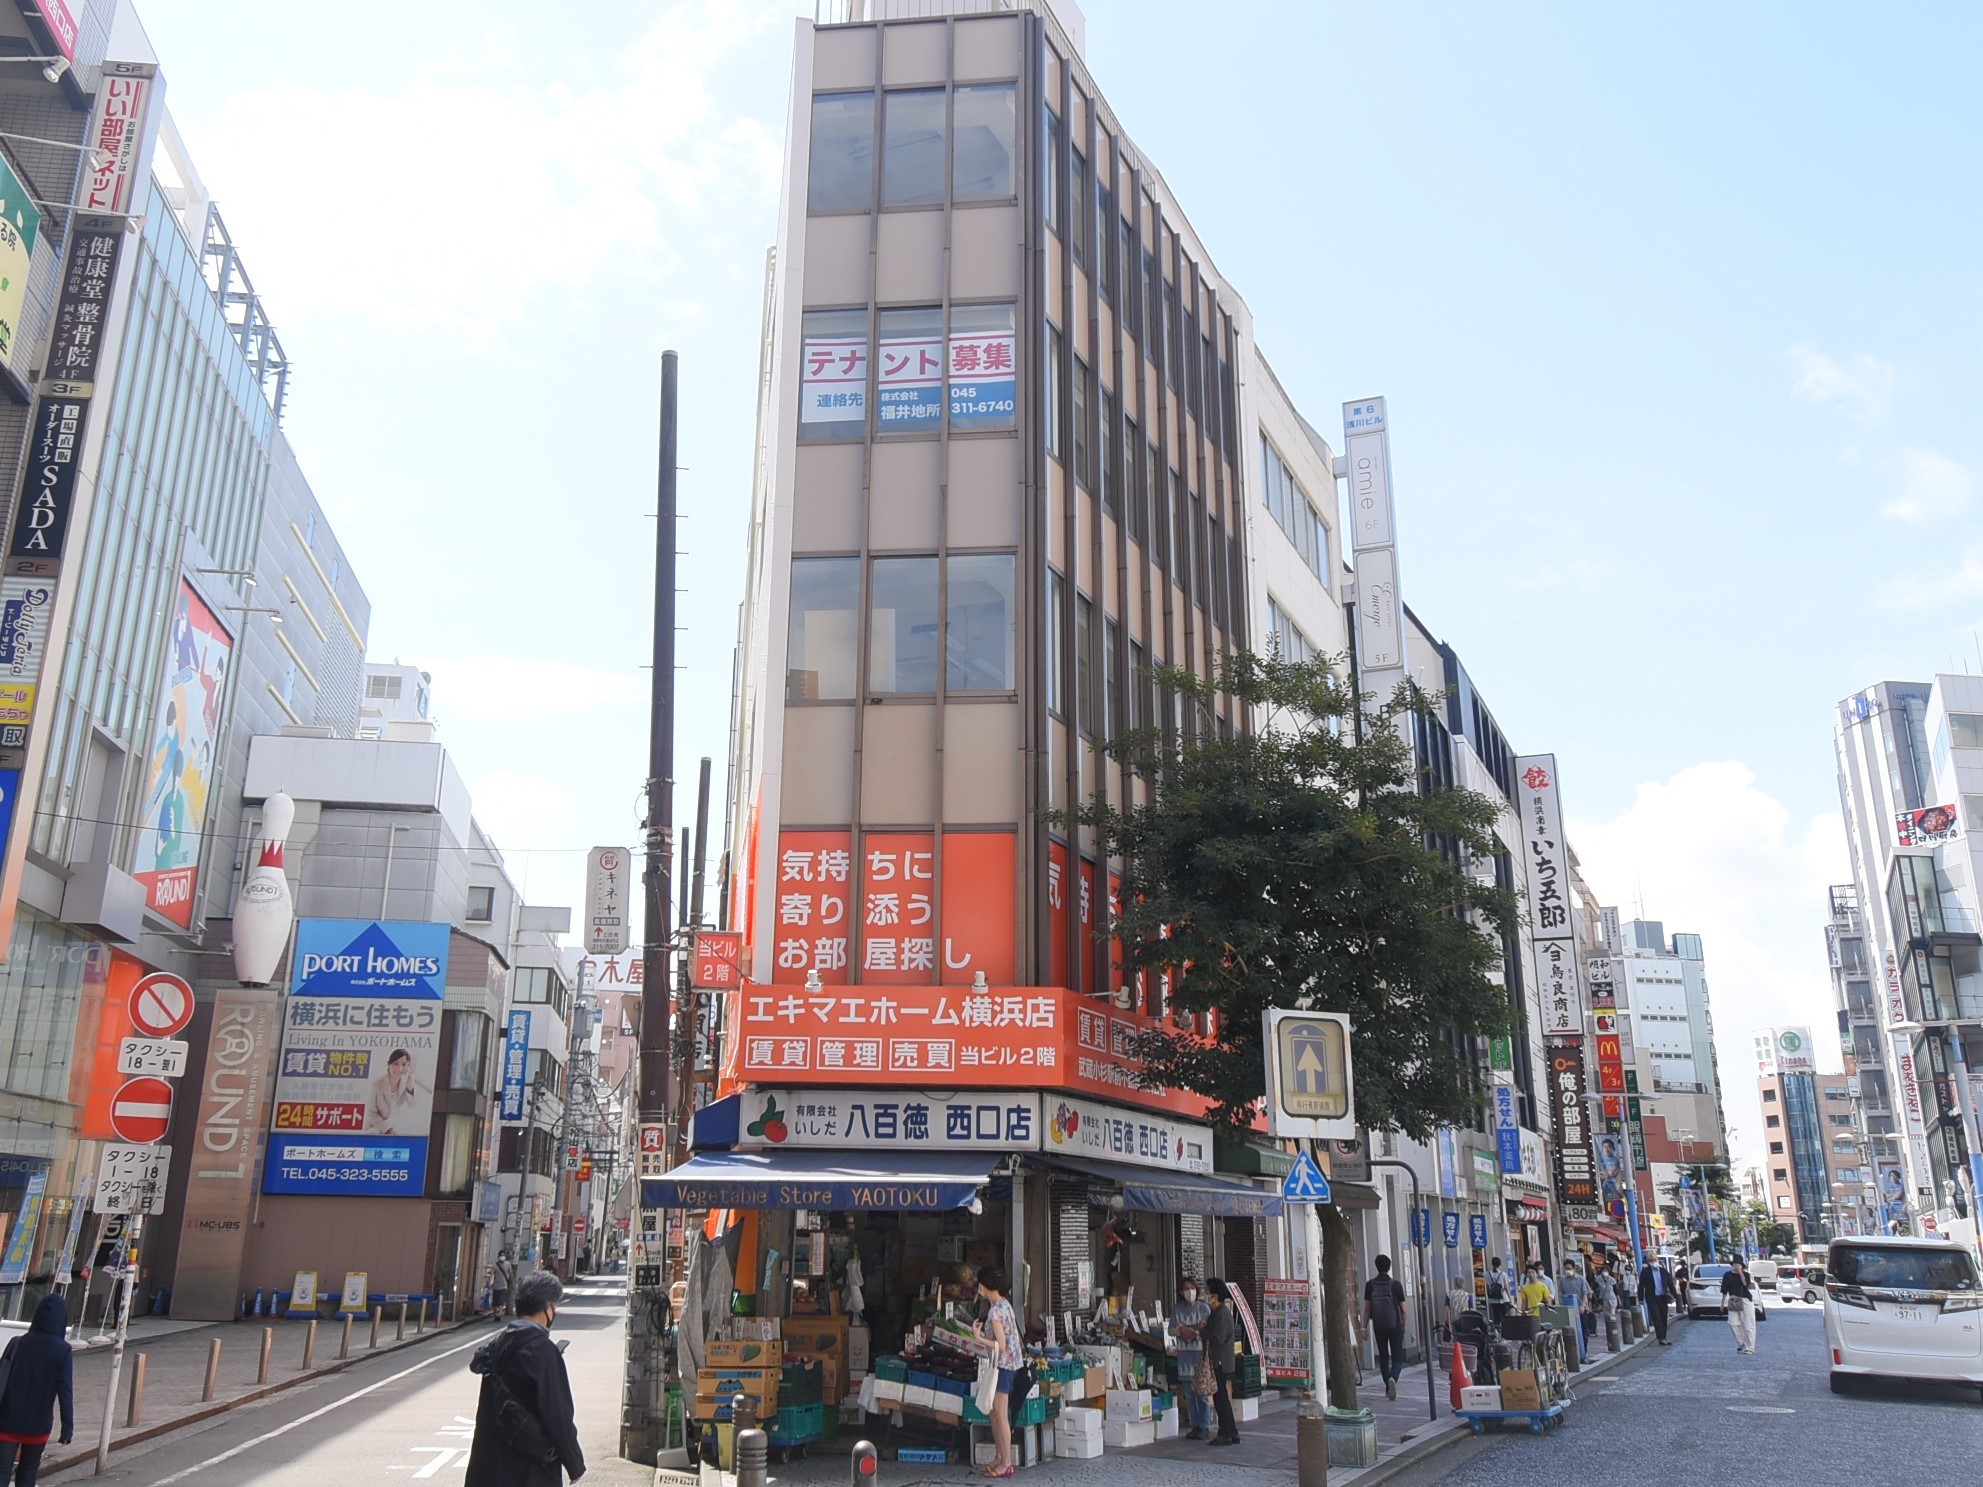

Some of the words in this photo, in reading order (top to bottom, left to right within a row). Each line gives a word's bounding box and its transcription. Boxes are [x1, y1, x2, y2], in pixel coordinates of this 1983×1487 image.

[115, 63, 144, 74] 5F
[118, 121, 136, 172] お部屋さがしは
[84, 218, 113, 229] 4F
[51, 384, 82, 395] 3F
[881, 391, 919, 402] 株式会社
[951, 387, 977, 398] 045
[817, 392, 864, 408] 連絡先
[951, 400, 1014, 414] 311-6740
[881, 404, 941, 420] 福井地所
[38, 404, 60, 463] オーダースーツ
[55, 405, 81, 463] 工場直販
[1358, 457, 1377, 510] amie
[25, 465, 59, 549] SADA
[1365, 519, 1379, 530] 6F
[17, 561, 48, 572] 2F
[1375, 653, 1389, 663] 5F
[781, 849, 933, 882] 気持ちに
[604, 871, 618, 915] キネヤ
[1531, 839, 1567, 929] いち五郎
[780, 893, 932, 926] 寄り添う
[698, 940, 736, 957] 当ビル
[778, 937, 971, 971] お部屋探し
[302, 952, 362, 981] PORT
[367, 946, 439, 976] HOMES
[703, 964, 730, 981] 2階
[289, 1001, 436, 1030] 横浜に住もう
[747, 995, 1056, 1028] エキマエホーム横浜店
[1079, 1013, 1105, 1048] 賃貸
[125, 1042, 182, 1056] タクシー
[288, 1032, 327, 1048] Living
[332, 1034, 345, 1047] In
[349, 1035, 433, 1049] YOKOHAMA
[284, 1052, 326, 1074] 賃貸
[329, 1051, 369, 1065] 物件数
[750, 1039, 806, 1067] 賃貸
[822, 1041, 877, 1068] 管理
[894, 1041, 951, 1068] 売買
[960, 1046, 1056, 1067] 当ビル2階
[328, 1065, 366, 1077] NO.1
[245, 1062, 261, 1121] AMUSEMENT
[795, 1104, 838, 1118] 有限会社
[1496, 1088, 1514, 1128] 処方せん
[1558, 1072, 1583, 1145] 俺の部屋
[795, 1120, 837, 1137] いしだ
[844, 1102, 930, 1141] 八百徳
[946, 1103, 1032, 1142] 西口店
[240, 1127, 250, 1158] SPACE
[1082, 1132, 1100, 1147] いしだ
[1103, 1118, 1135, 1155] 八百徳
[1139, 1124, 1169, 1161] 西口店
[108, 1150, 166, 1163] タクシー
[281, 1168, 409, 1182] TEL.045-323-5555
[780, 1185, 832, 1205] Store
[851, 1186, 939, 1207] YAOTOKU
[1567, 1183, 1591, 1195] 24H
